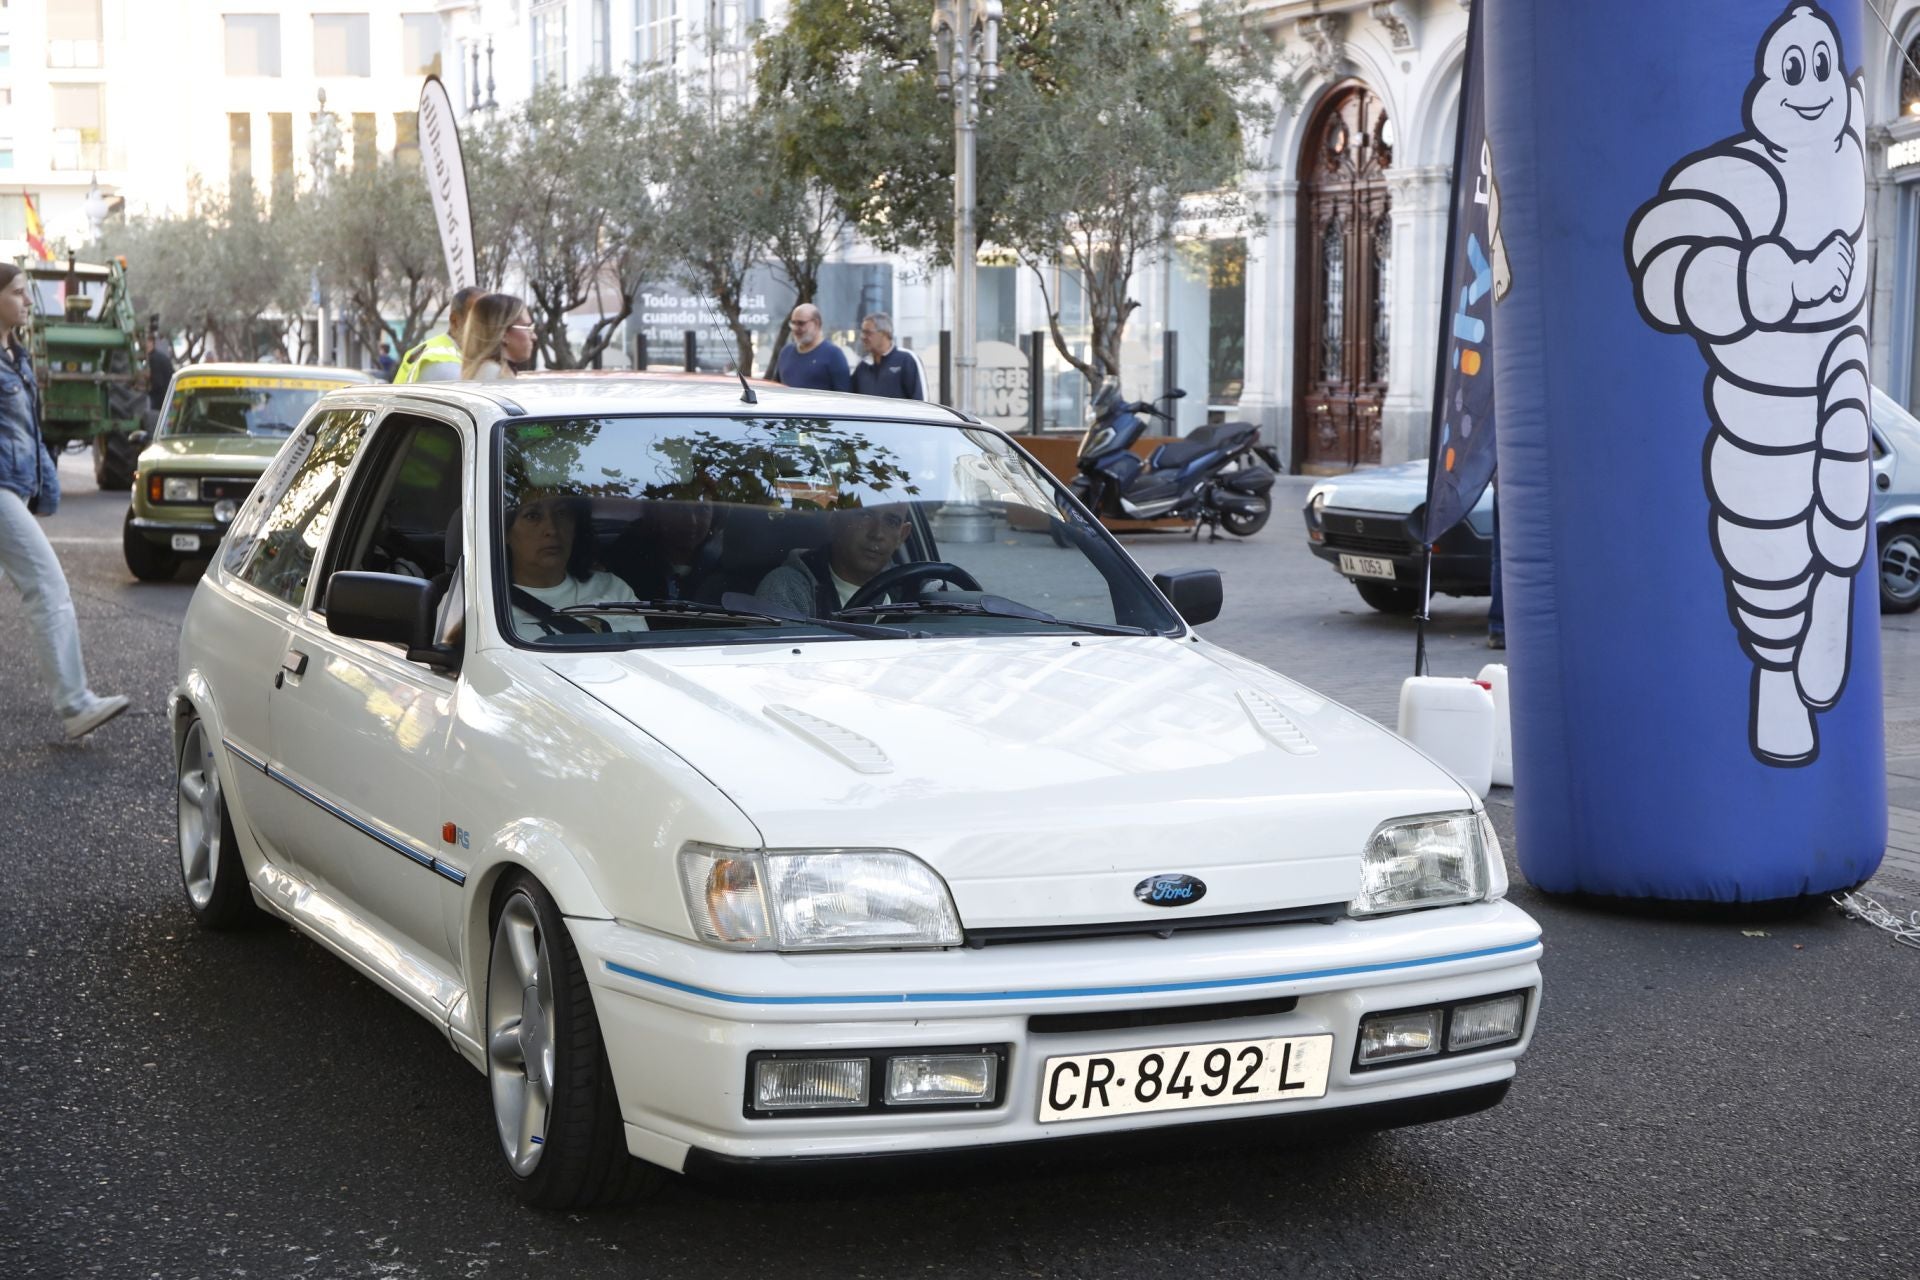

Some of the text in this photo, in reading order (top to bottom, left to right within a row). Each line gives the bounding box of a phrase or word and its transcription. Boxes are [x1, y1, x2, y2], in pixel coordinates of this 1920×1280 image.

[641, 293, 678, 308] Todo
[681, 296, 698, 308] es
[733, 294, 765, 308] ácil
[642, 310, 770, 325] cuando habmos
[660, 326, 708, 340] miso
[977, 368, 1029, 389] RGER
[977, 388, 1029, 417] ING
[1342, 555, 1393, 576] VA 1053 J
[457, 827, 470, 849] RS
[1152, 880, 1192, 900] Ford
